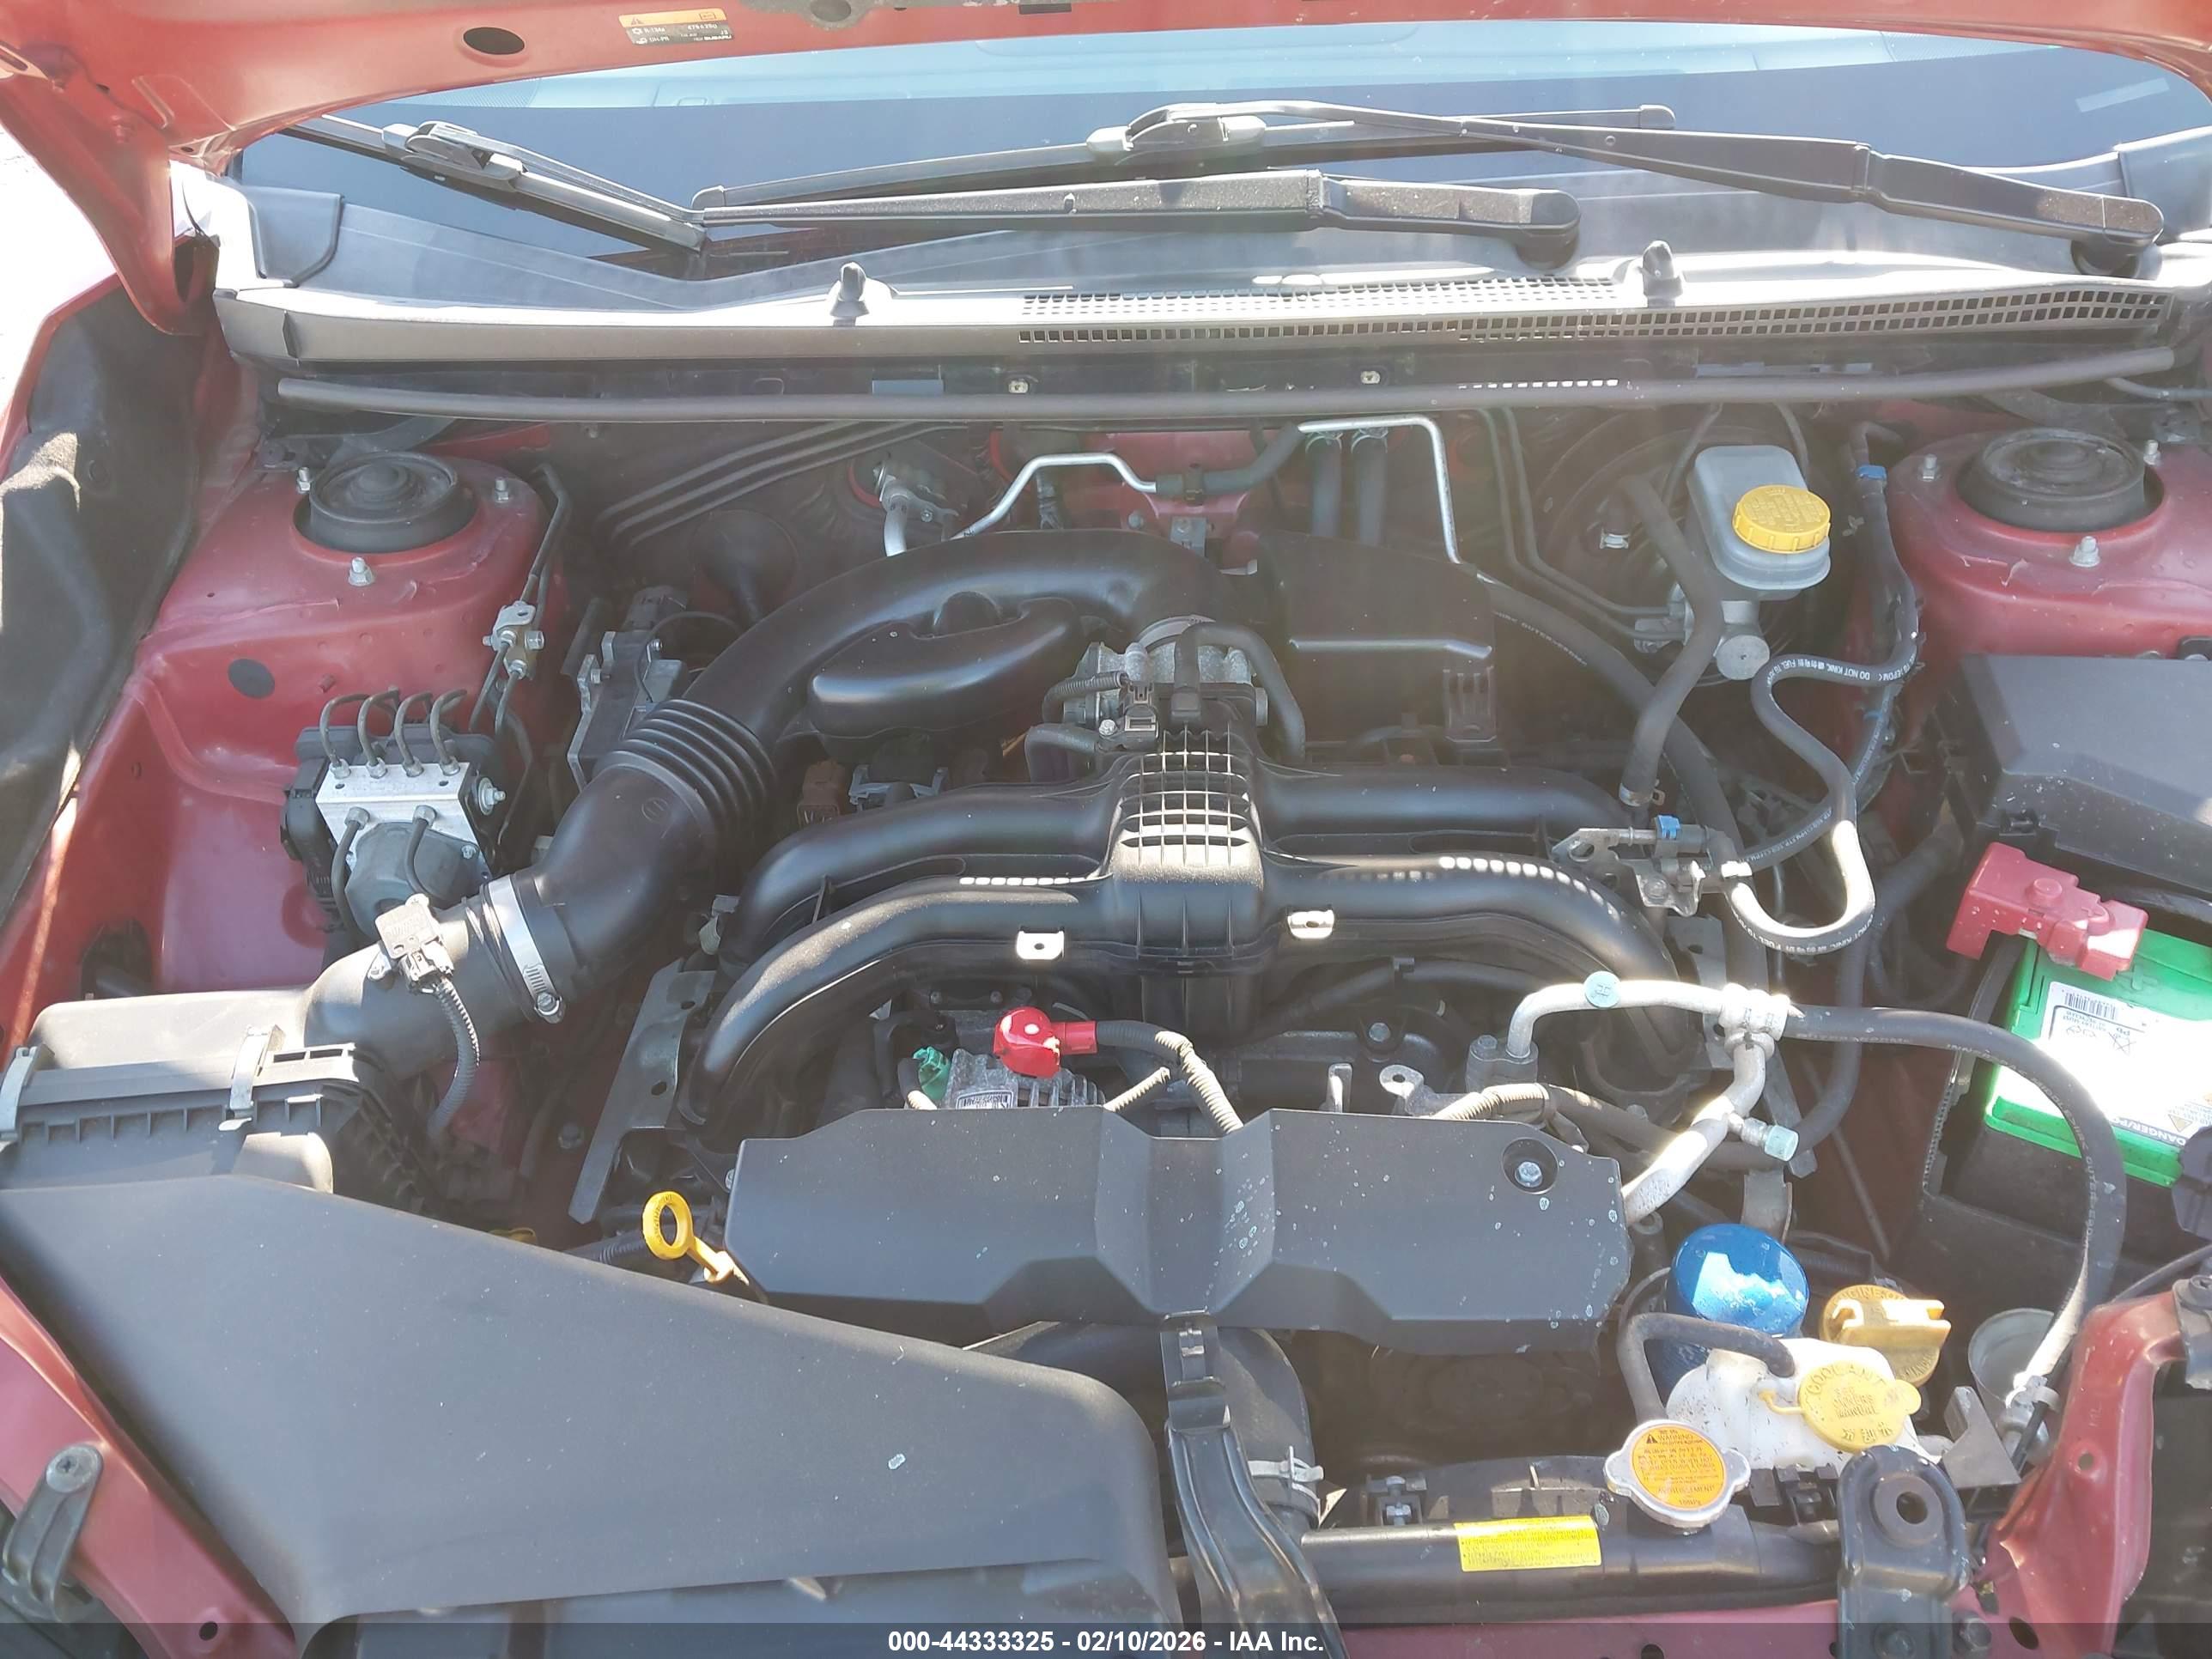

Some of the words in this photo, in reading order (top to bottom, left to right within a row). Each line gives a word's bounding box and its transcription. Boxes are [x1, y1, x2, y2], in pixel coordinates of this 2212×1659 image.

[1844, 667, 1860, 679] NOT
[1858, 671, 1871, 681] DO
[1806, 1363, 1887, 1395] COOLANT
[1657, 1433, 1694, 1442] WARNING
